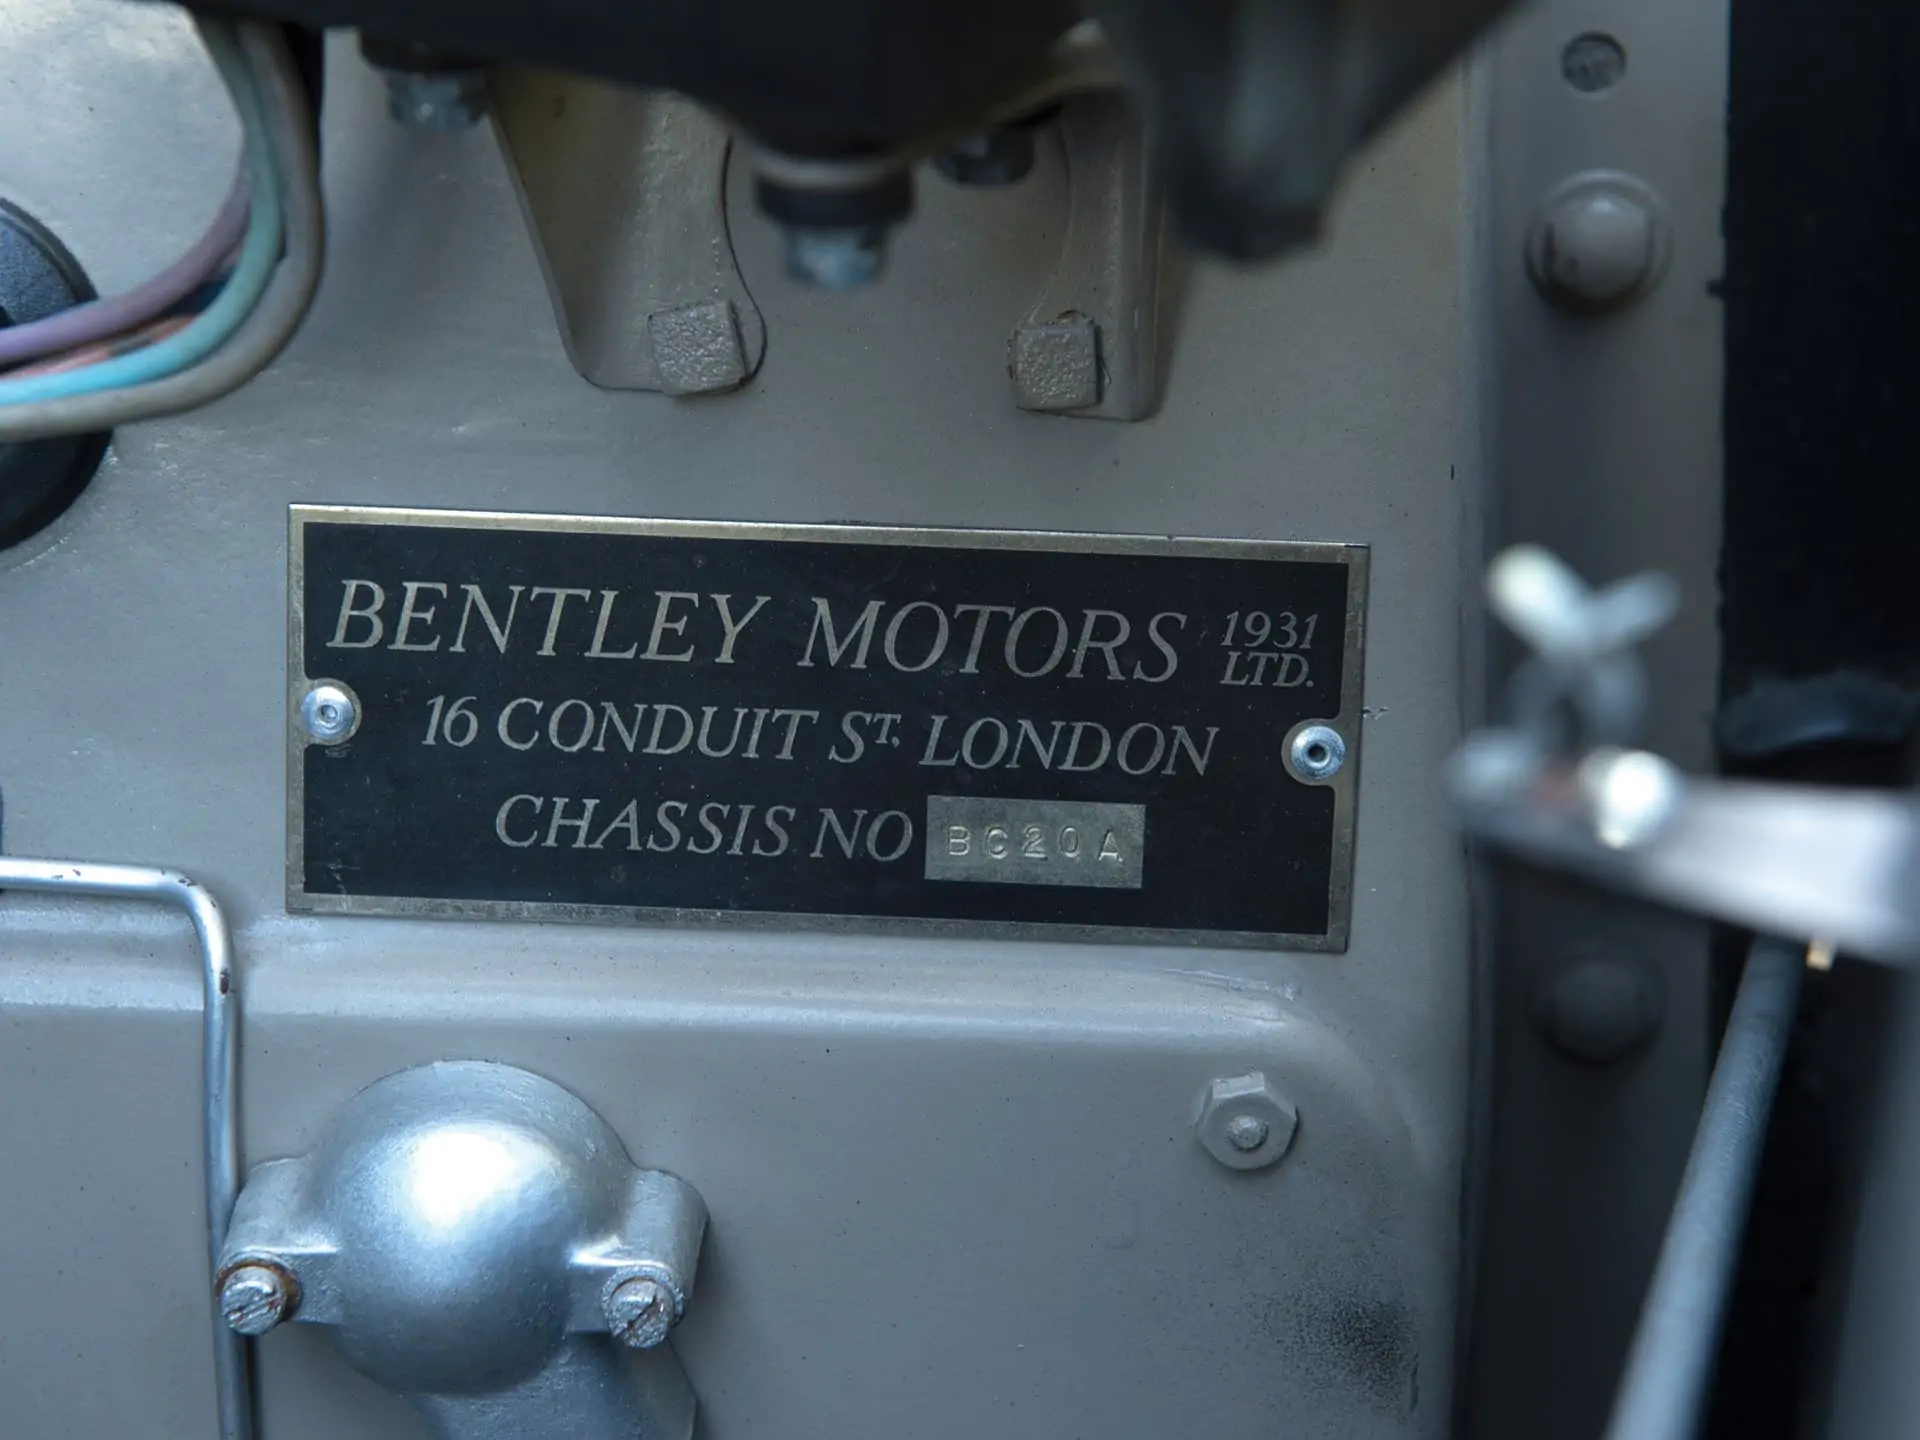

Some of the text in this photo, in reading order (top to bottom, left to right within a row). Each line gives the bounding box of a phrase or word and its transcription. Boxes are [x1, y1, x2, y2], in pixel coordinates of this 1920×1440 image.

[327, 579, 1188, 683] BENTLEY MOTORS
[1220, 610, 1319, 650] 1931
[1220, 652, 1316, 688] LTD.
[422, 695, 479, 747] 16
[497, 697, 819, 759] CONDUIT
[919, 715, 1220, 776] LONDON
[495, 795, 1125, 863] CHASSIS NO BC20A
